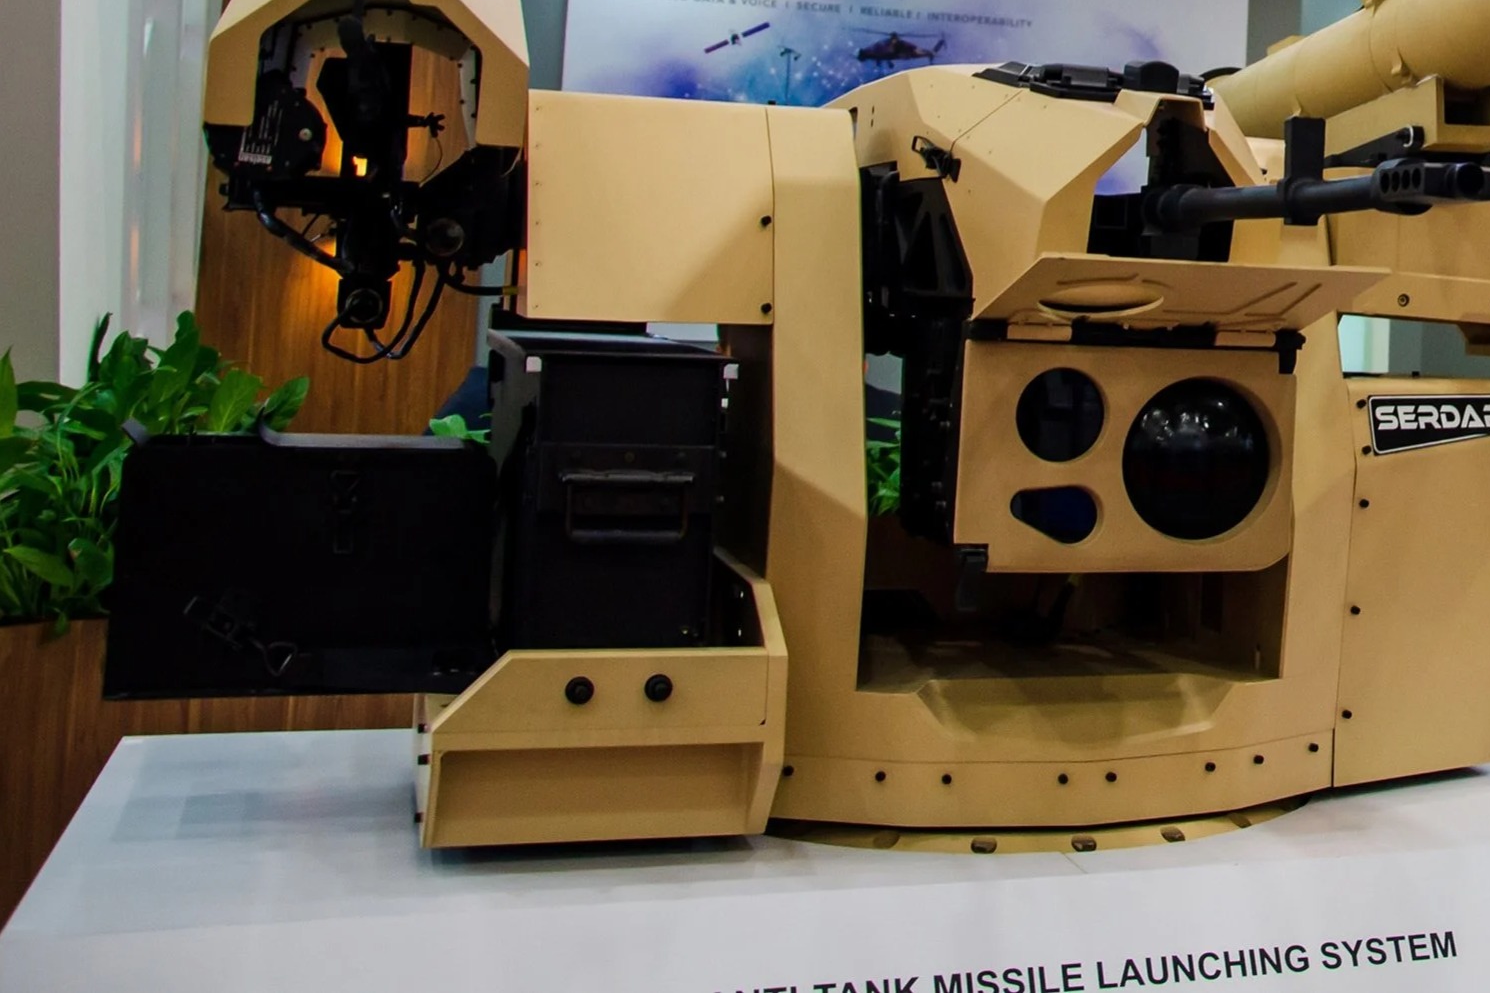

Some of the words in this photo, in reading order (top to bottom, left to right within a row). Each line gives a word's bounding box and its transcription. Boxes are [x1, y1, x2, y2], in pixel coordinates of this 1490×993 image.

[796, 1, 841, 13] SECURE
[860, 7, 912, 20] RELIABLE
[927, 12, 1032, 28] INTEROPERABILITY
[933, 963, 1085, 993] MISSILE
[1096, 945, 1310, 989] LAUNCHING
[1320, 931, 1458, 969] SYSTEM
